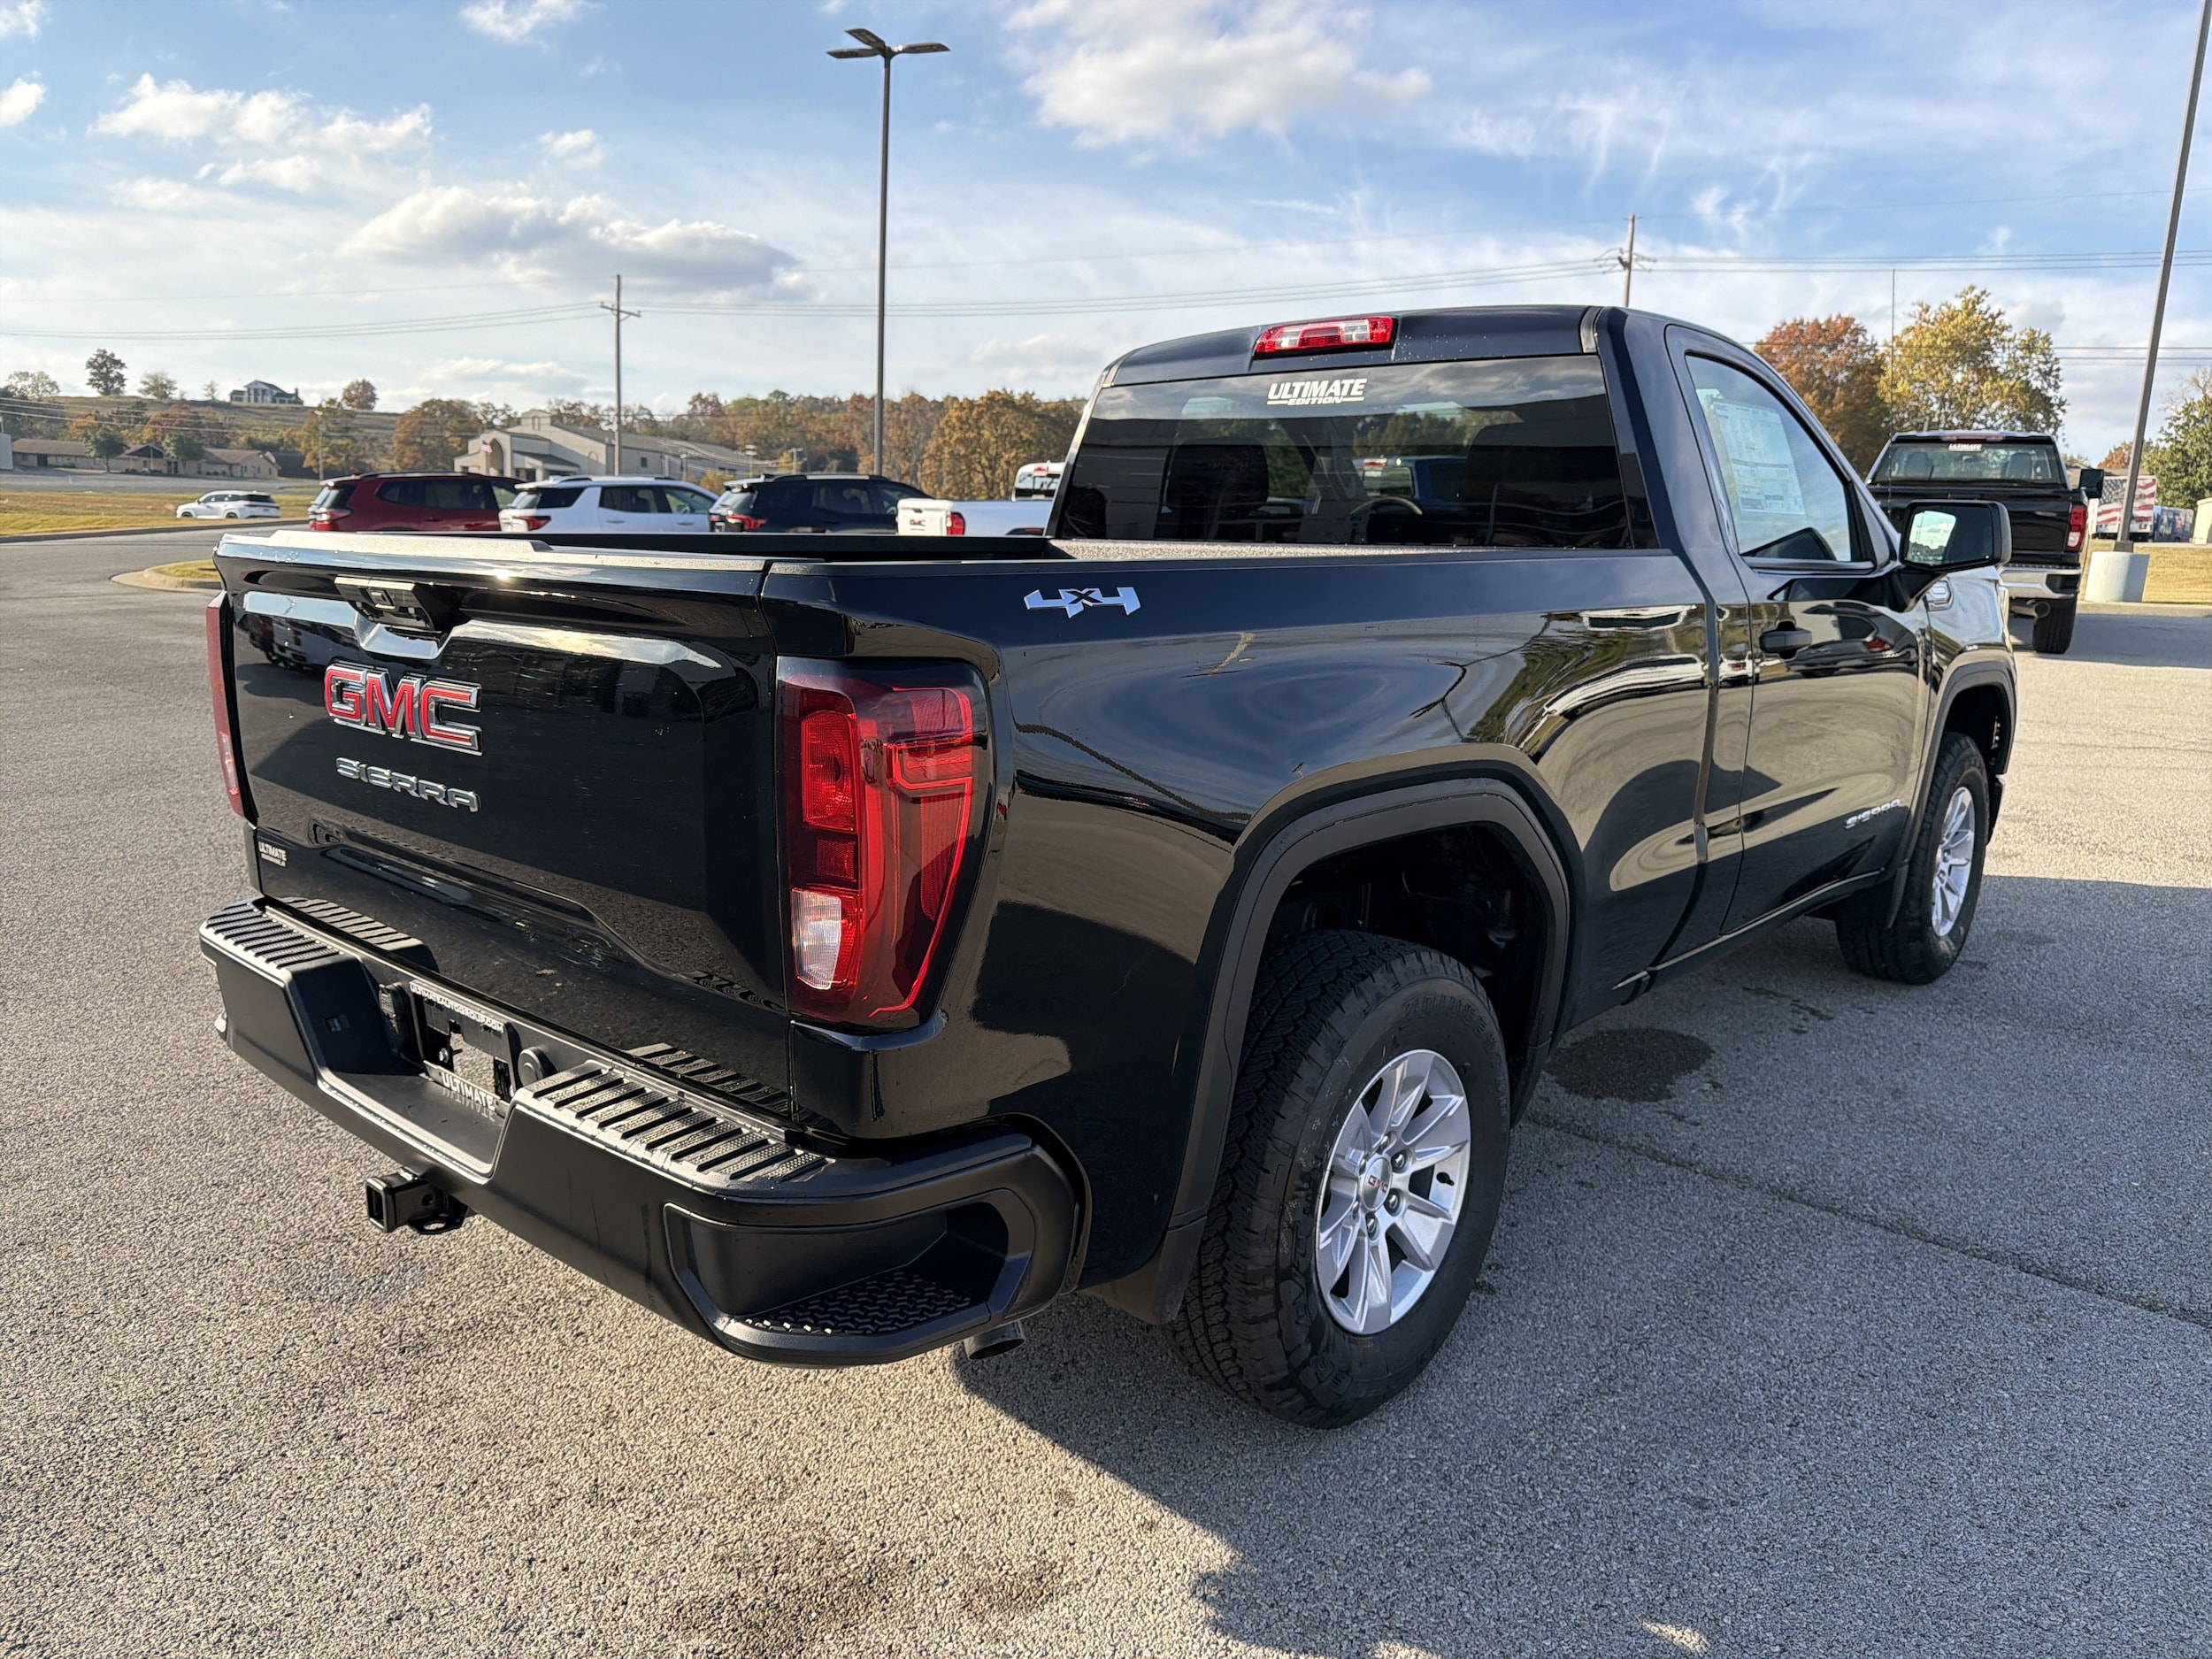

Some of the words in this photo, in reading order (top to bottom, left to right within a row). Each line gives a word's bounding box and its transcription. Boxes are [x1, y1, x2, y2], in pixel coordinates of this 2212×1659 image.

[1267, 378, 1368, 399] ULTIMATE
[1287, 396, 1343, 406] EDITION
[324, 660, 483, 756] GMC
[335, 757, 481, 812] SIERRA
[258, 841, 287, 861] ULTIMATE
[442, 1071, 495, 1111] ULTIMATE
[1368, 1175, 1388, 1194] GMC
